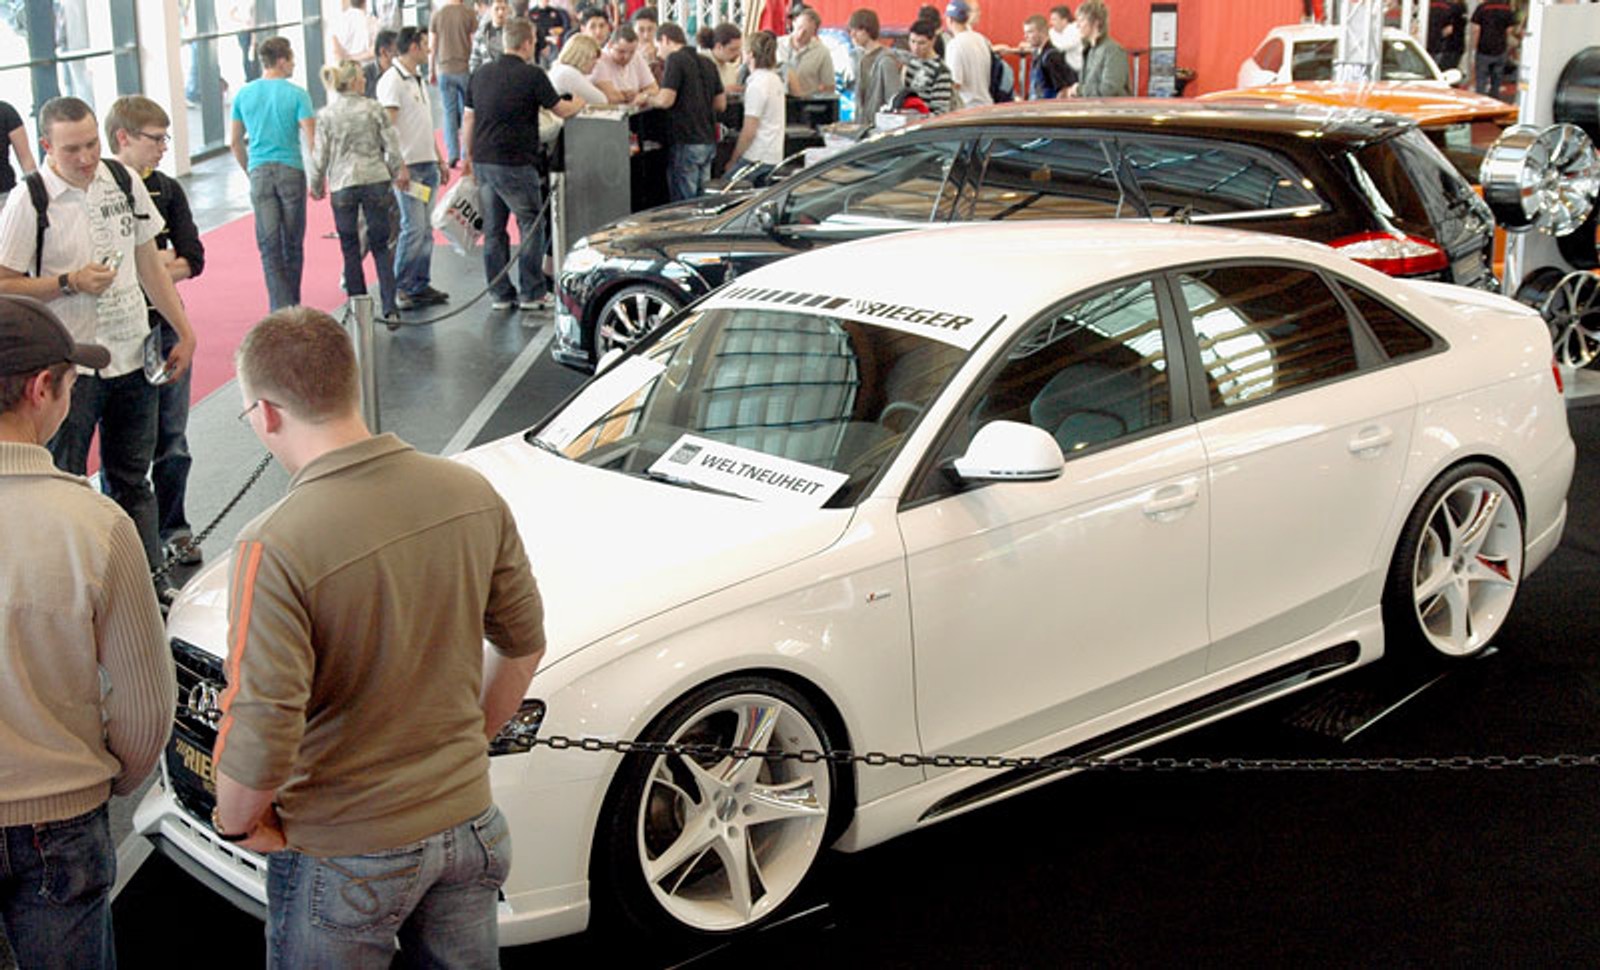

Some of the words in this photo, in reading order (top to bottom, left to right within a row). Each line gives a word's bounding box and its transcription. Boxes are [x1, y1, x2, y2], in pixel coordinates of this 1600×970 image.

[119, 216, 132, 238] 3
[855, 301, 974, 331] RIEGER
[700, 453, 825, 496] WELTNEUHEIT
